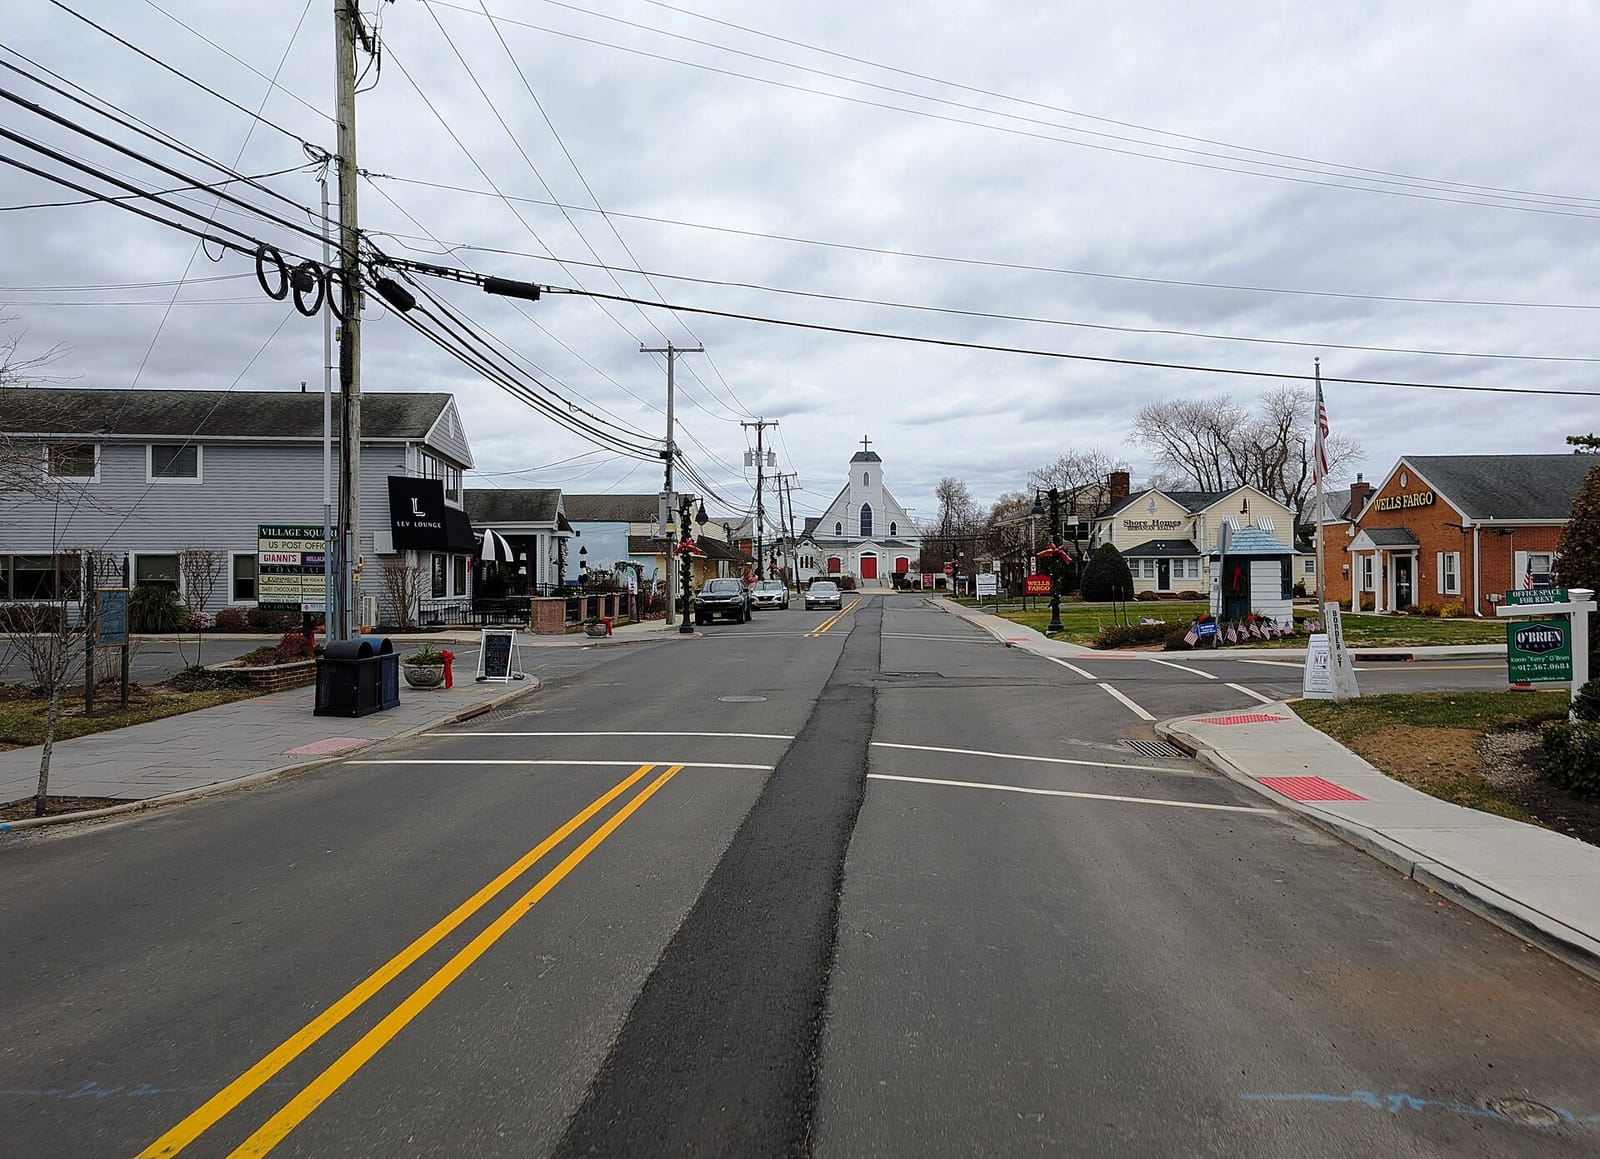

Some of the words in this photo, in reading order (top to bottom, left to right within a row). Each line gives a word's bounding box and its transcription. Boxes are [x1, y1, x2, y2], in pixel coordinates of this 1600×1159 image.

[1374, 496, 1401, 511] WELLS
[1402, 491, 1433, 507] FARGO
[262, 528, 301, 537] VILLAGE
[268, 541, 279, 549] US
[282, 541, 302, 550] POST
[304, 542, 326, 550] OFFIC
[263, 554, 297, 562] GIANNI'S
[1538, 588, 1562, 596] SPACE
[1332, 610, 1342, 651] BORDER
[1517, 630, 1561, 643] O'BRIEN
[1336, 653, 1342, 668] ST
